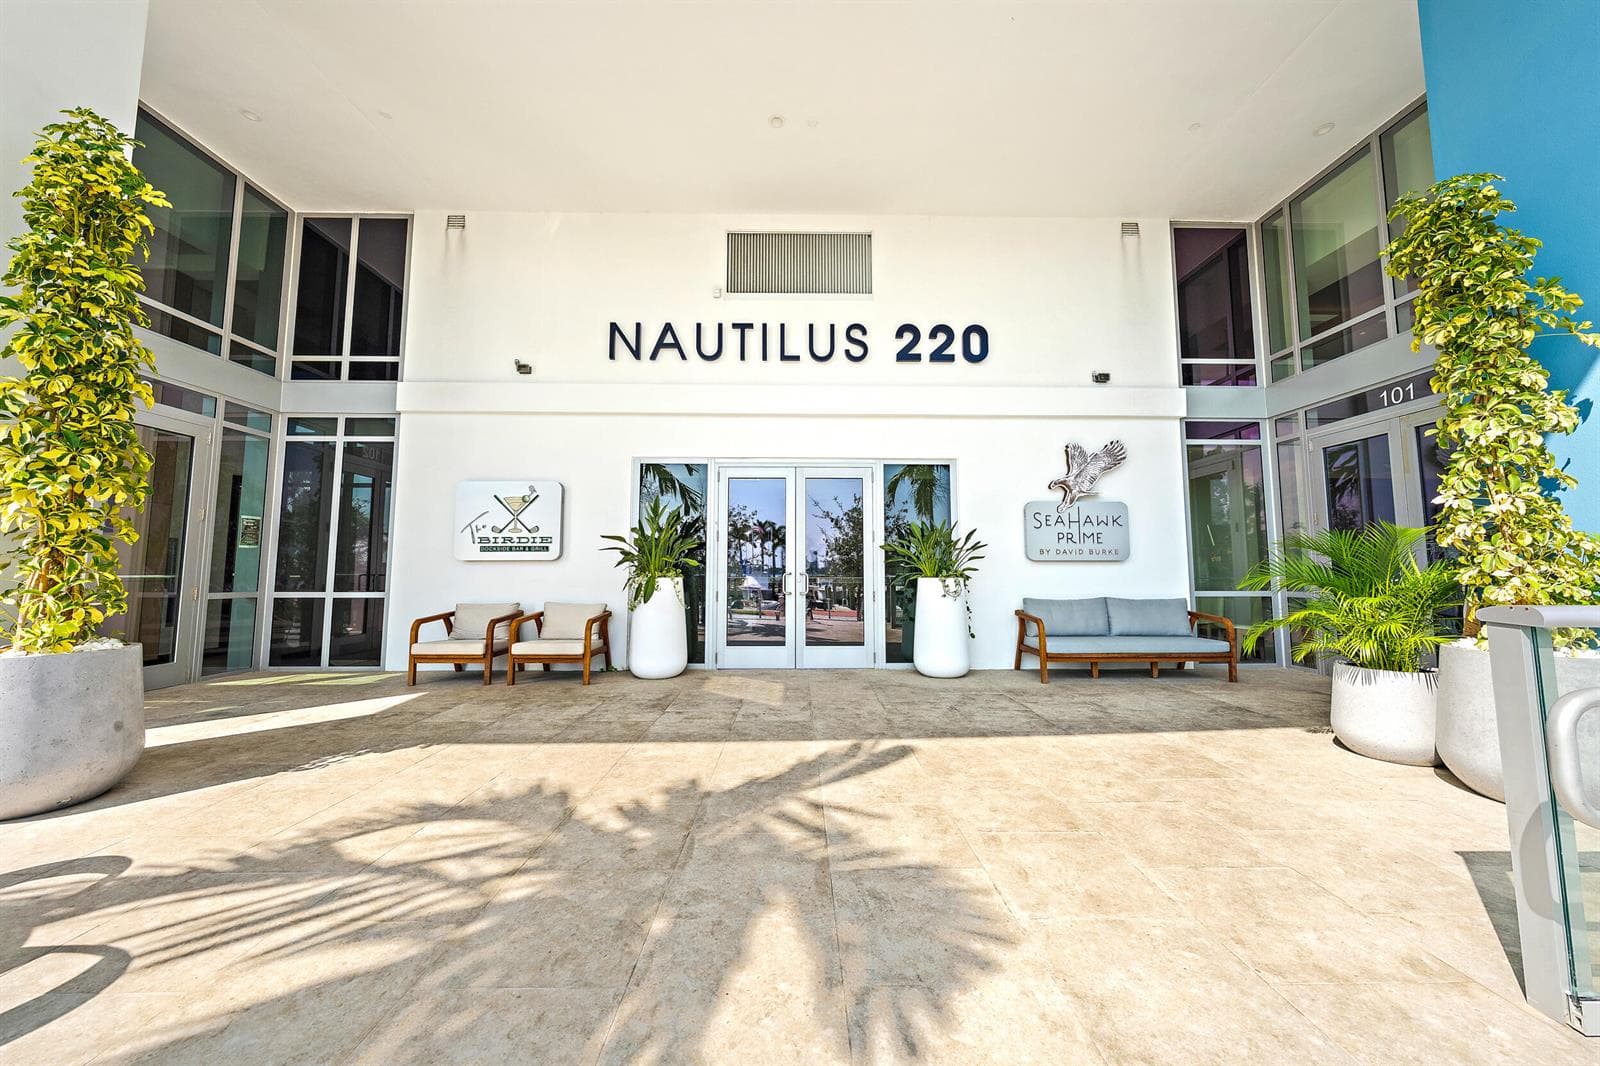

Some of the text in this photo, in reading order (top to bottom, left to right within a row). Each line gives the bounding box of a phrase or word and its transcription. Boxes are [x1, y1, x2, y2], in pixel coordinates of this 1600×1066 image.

[609, 322, 989, 363] NAUTILUS 220
[1379, 382, 1414, 407] 101
[477, 536, 552, 544] BIRDIE
[1057, 531, 1103, 544] PRIME
[1039, 548, 1120, 556] BY DAVID BURKE
